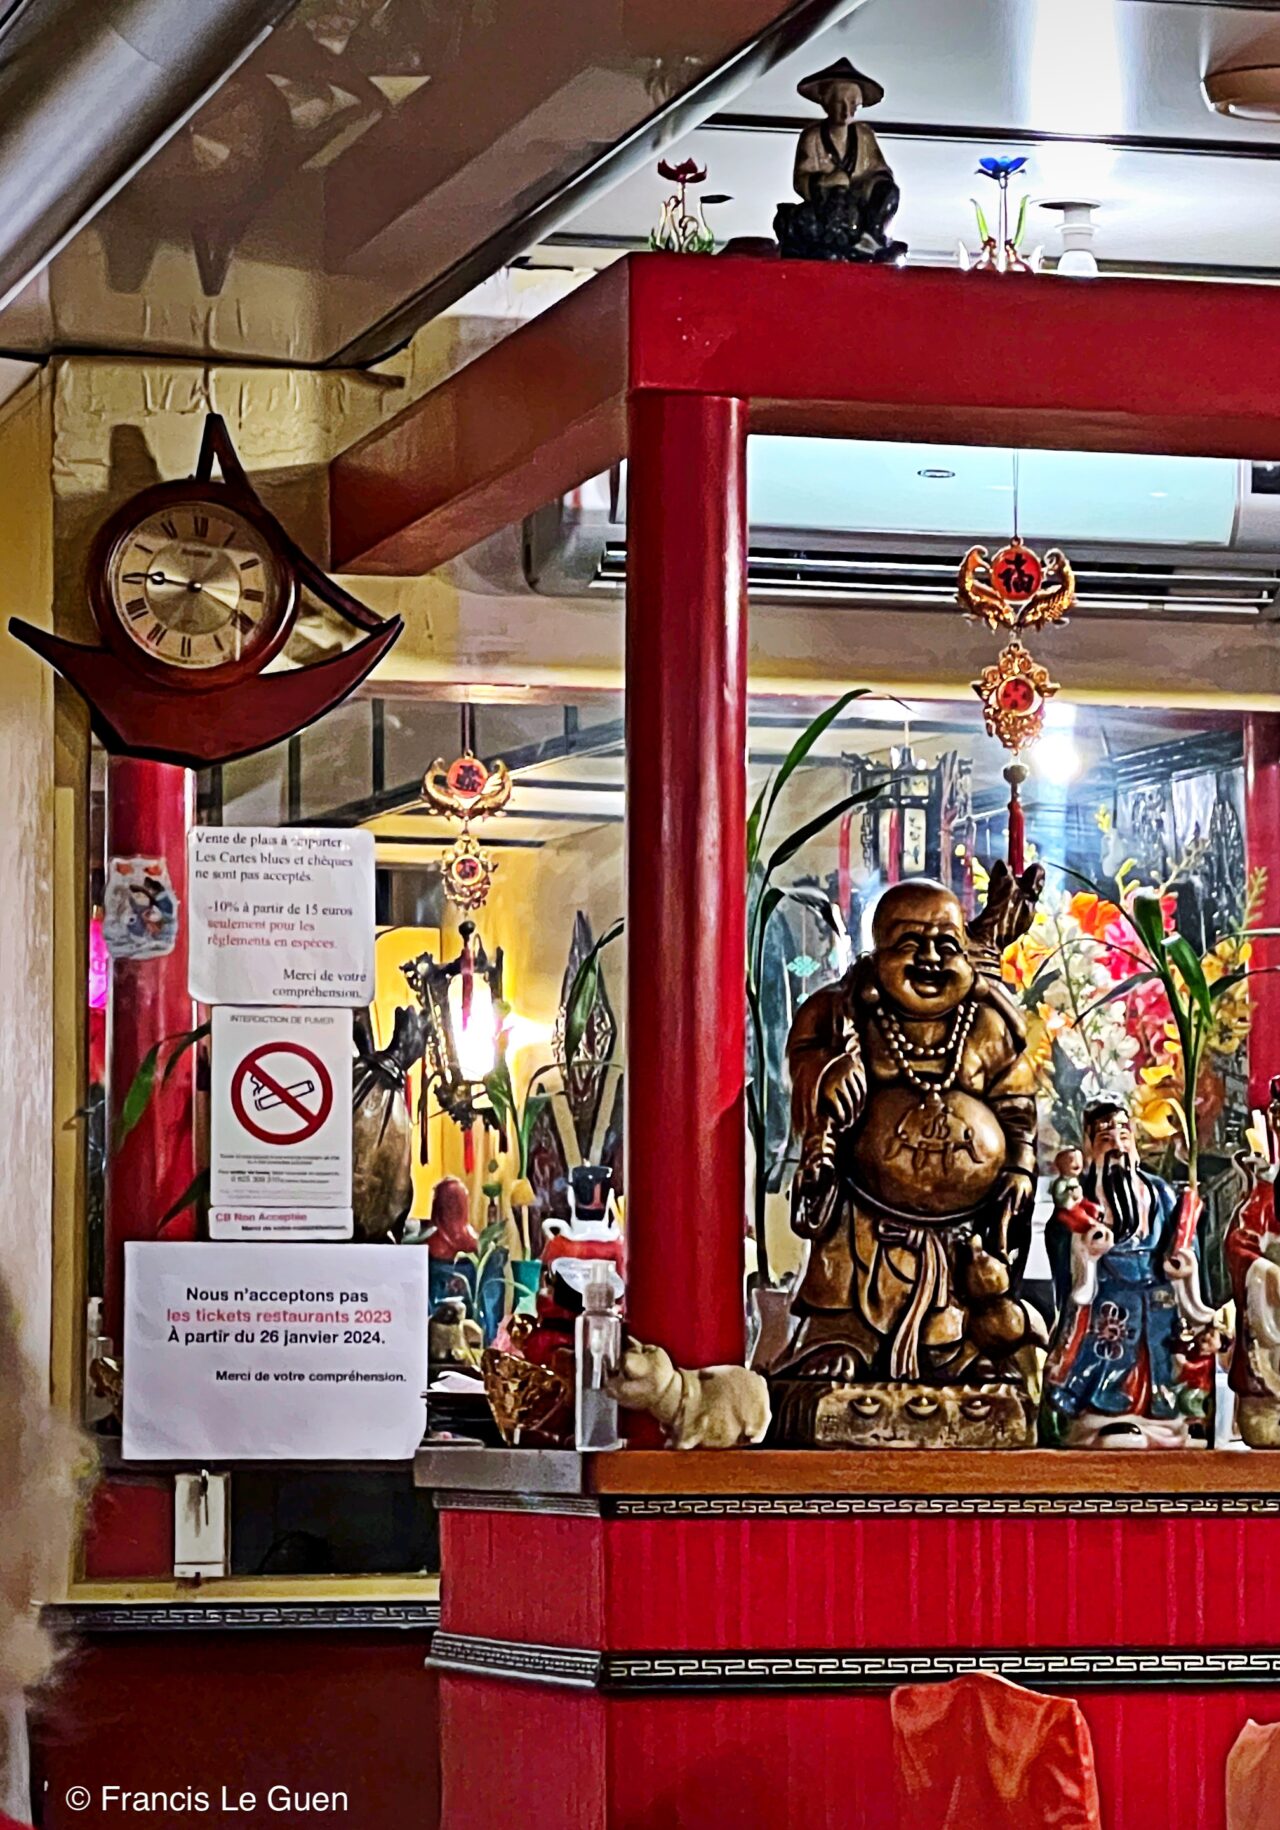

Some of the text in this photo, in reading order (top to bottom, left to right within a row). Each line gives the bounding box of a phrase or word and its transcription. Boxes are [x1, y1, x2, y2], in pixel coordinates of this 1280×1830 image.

[196, 832, 230, 844] Vente
[233, 832, 247, 844] de
[281, 835, 288, 845] à
[195, 850, 216, 862] Les
[220, 851, 257, 863] Cartes
[260, 852, 290, 864] blues
[294, 856, 304, 865] et
[195, 870, 209, 879] ne
[212, 870, 236, 880] sont
[240, 871, 260, 882] pas
[242, 902, 250, 914] à
[253, 904, 284, 917] partir
[287, 904, 301, 915] de
[305, 904, 318, 915] 15
[322, 907, 353, 916] euros
[208, 919, 315, 933] seulement pour les
[274, 938, 288, 948] en
[283, 968, 367, 982] Merci de votre
[230, 1014, 335, 1025] INTERDICTION DE FUMER
[234, 1212, 256, 1221] Non
[186, 1287, 229, 1302] Nous
[339, 1291, 369, 1305] pas
[166, 1309, 392, 1324] les tickets restaurants 2023
[167, 1325, 386, 1347] À partir du 26 janvier 2024.
[216, 1370, 407, 1384] Merci de votre compréhension.
